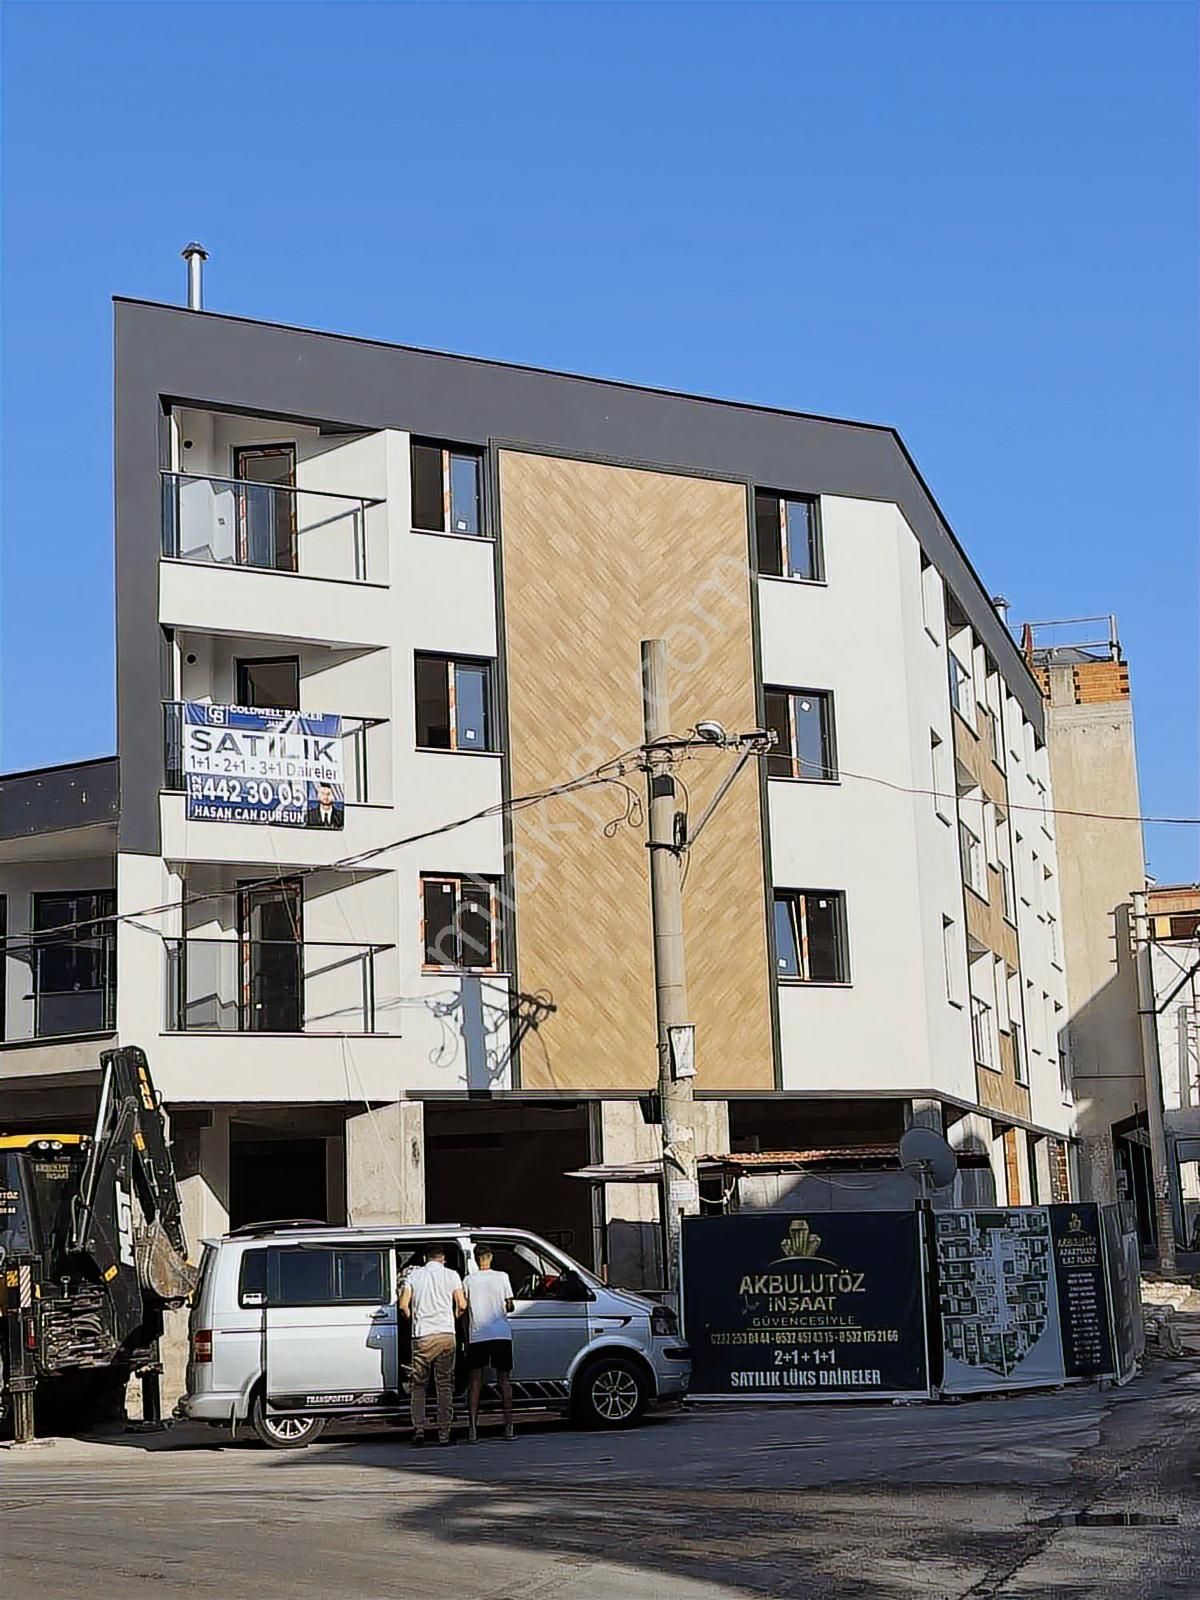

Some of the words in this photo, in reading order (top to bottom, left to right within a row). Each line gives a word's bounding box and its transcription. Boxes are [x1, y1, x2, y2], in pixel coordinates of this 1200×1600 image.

[230, 704, 283, 717] COLDWELL
[190, 729, 336, 763] SATILIK
[191, 755, 210, 770] 1+1
[223, 758, 246, 773] 2+1
[259, 761, 282, 776] 3+1
[203, 777, 242, 802] 442
[195, 805, 232, 820] HASAN
[235, 808, 258, 821] CAN
[739, 1269, 866, 1294] AKBULUTÖZ
[774, 1349, 799, 1365] 2+1
[812, 1349, 836, 1364] 1+1
[730, 1371, 781, 1387] SATILIK
[783, 1368, 817, 1386] LÜKS
[819, 1367, 881, 1385] DAİRELER
